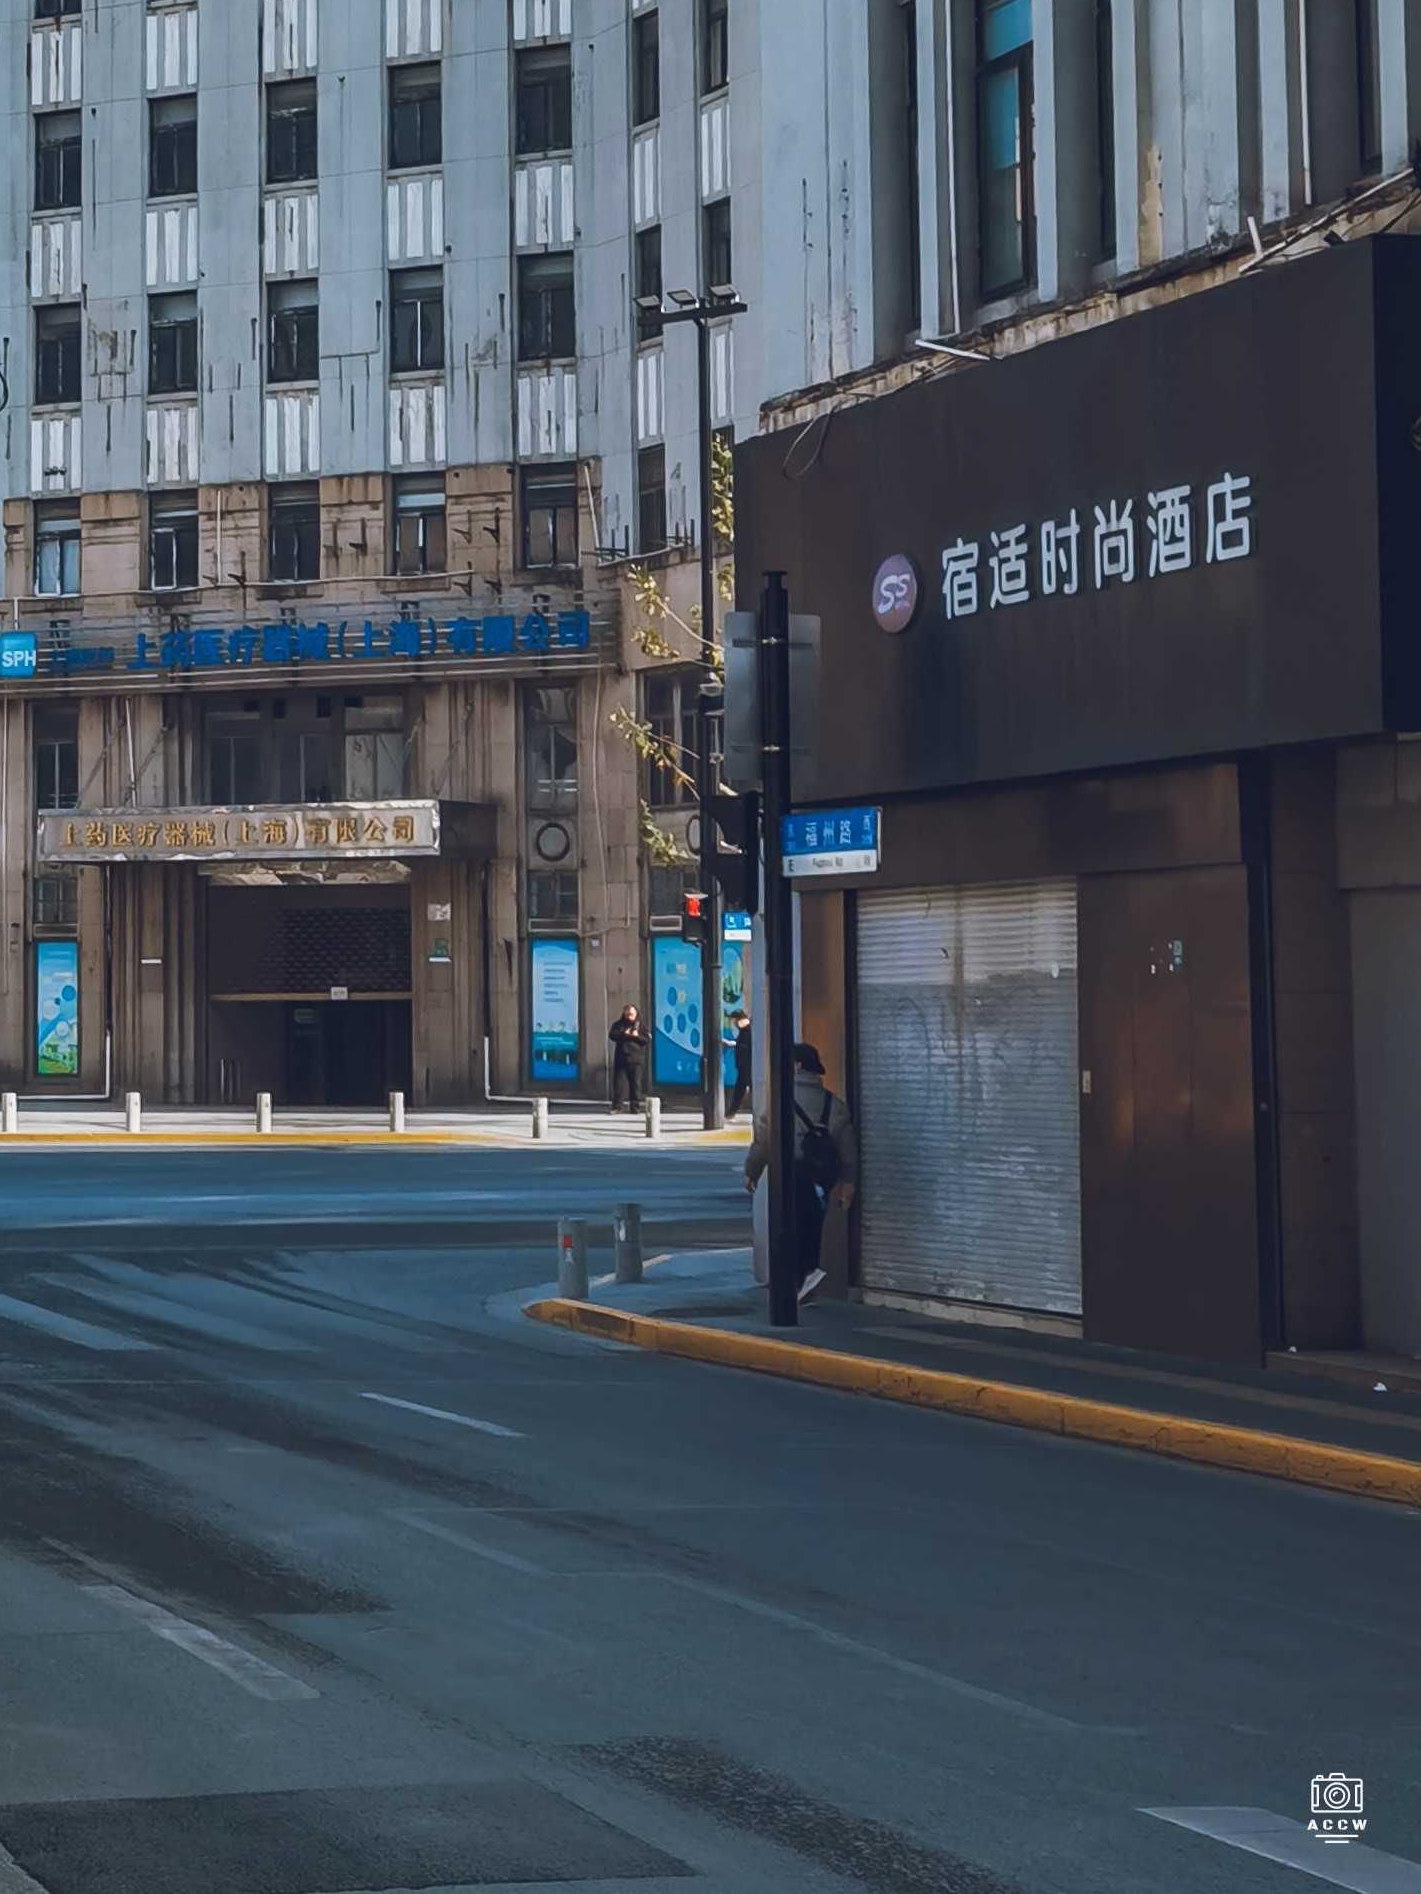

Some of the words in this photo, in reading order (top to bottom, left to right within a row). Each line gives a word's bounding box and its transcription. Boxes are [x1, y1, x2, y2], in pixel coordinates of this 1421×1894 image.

[941, 472, 1252, 620] 宿适时尚酒店
[1, 649, 36, 668] SPH
